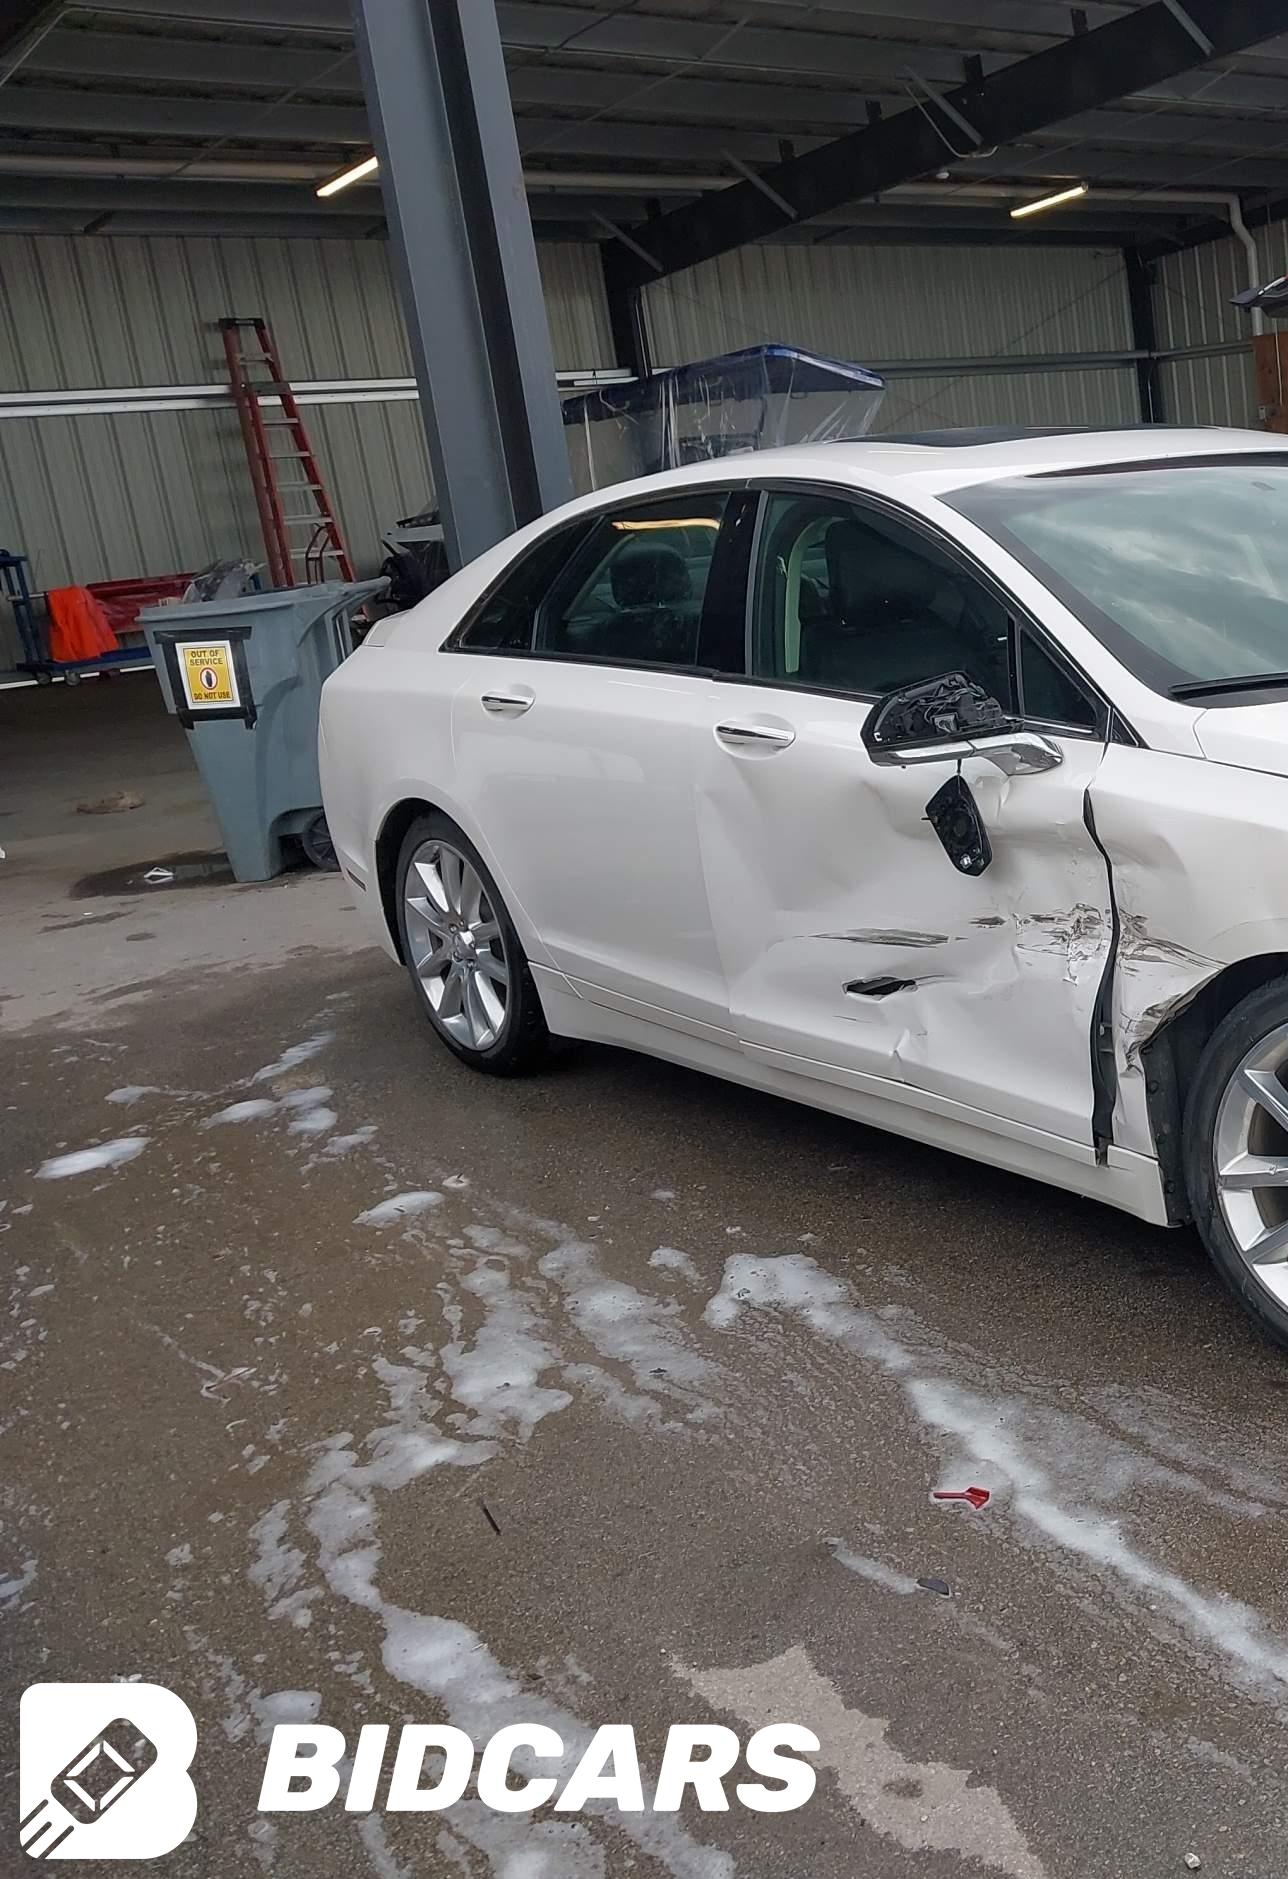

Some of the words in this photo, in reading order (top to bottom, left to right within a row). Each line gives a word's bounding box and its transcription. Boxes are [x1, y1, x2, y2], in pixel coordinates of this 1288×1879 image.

[190, 650, 207, 658] OUT
[190, 658, 223, 666] SERVICE
[193, 692, 203, 700] DO
[204, 692, 218, 700] NOT
